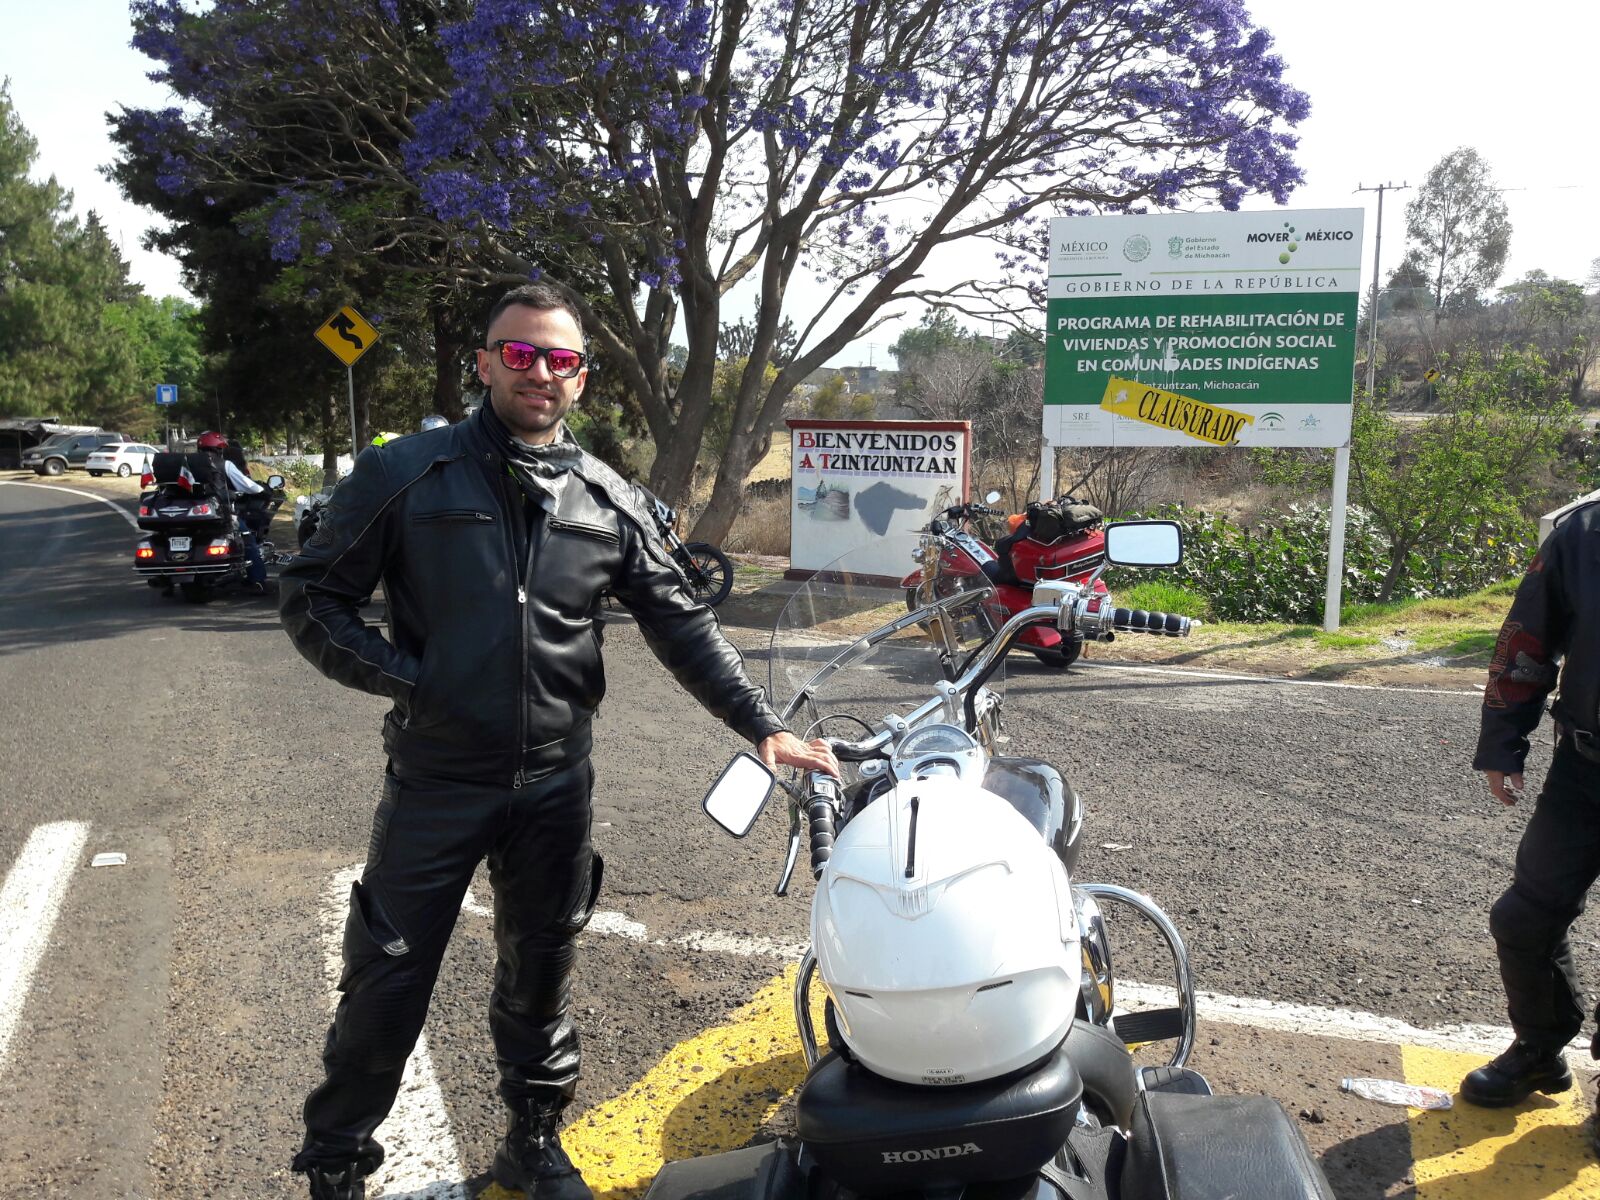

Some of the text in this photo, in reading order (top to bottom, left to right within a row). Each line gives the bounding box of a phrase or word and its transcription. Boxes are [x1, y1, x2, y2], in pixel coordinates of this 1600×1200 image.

[1247, 229, 1354, 243] MOVER MÉXICO
[1060, 240, 1108, 252] MÉXICO
[1066, 274, 1339, 294] GOBIERNO DE LA REPÚBLICA
[1057, 310, 1345, 330] PROGRAMA DE REHABILITACIÓN DE
[1063, 332, 1336, 351] VIVIENDAS Y PROMOCIÓN SOCIAL
[1077, 359, 1097, 372] EN
[1227, 353, 1319, 370] INDÍGENAS
[1203, 379, 1260, 390] Michoacán
[1072, 412, 1090, 421] SRE
[798, 432, 957, 451] BIENVENIDOS
[798, 453, 957, 474] A TZINTZUNTZAN
[881, 1142, 983, 1163] HONDA
